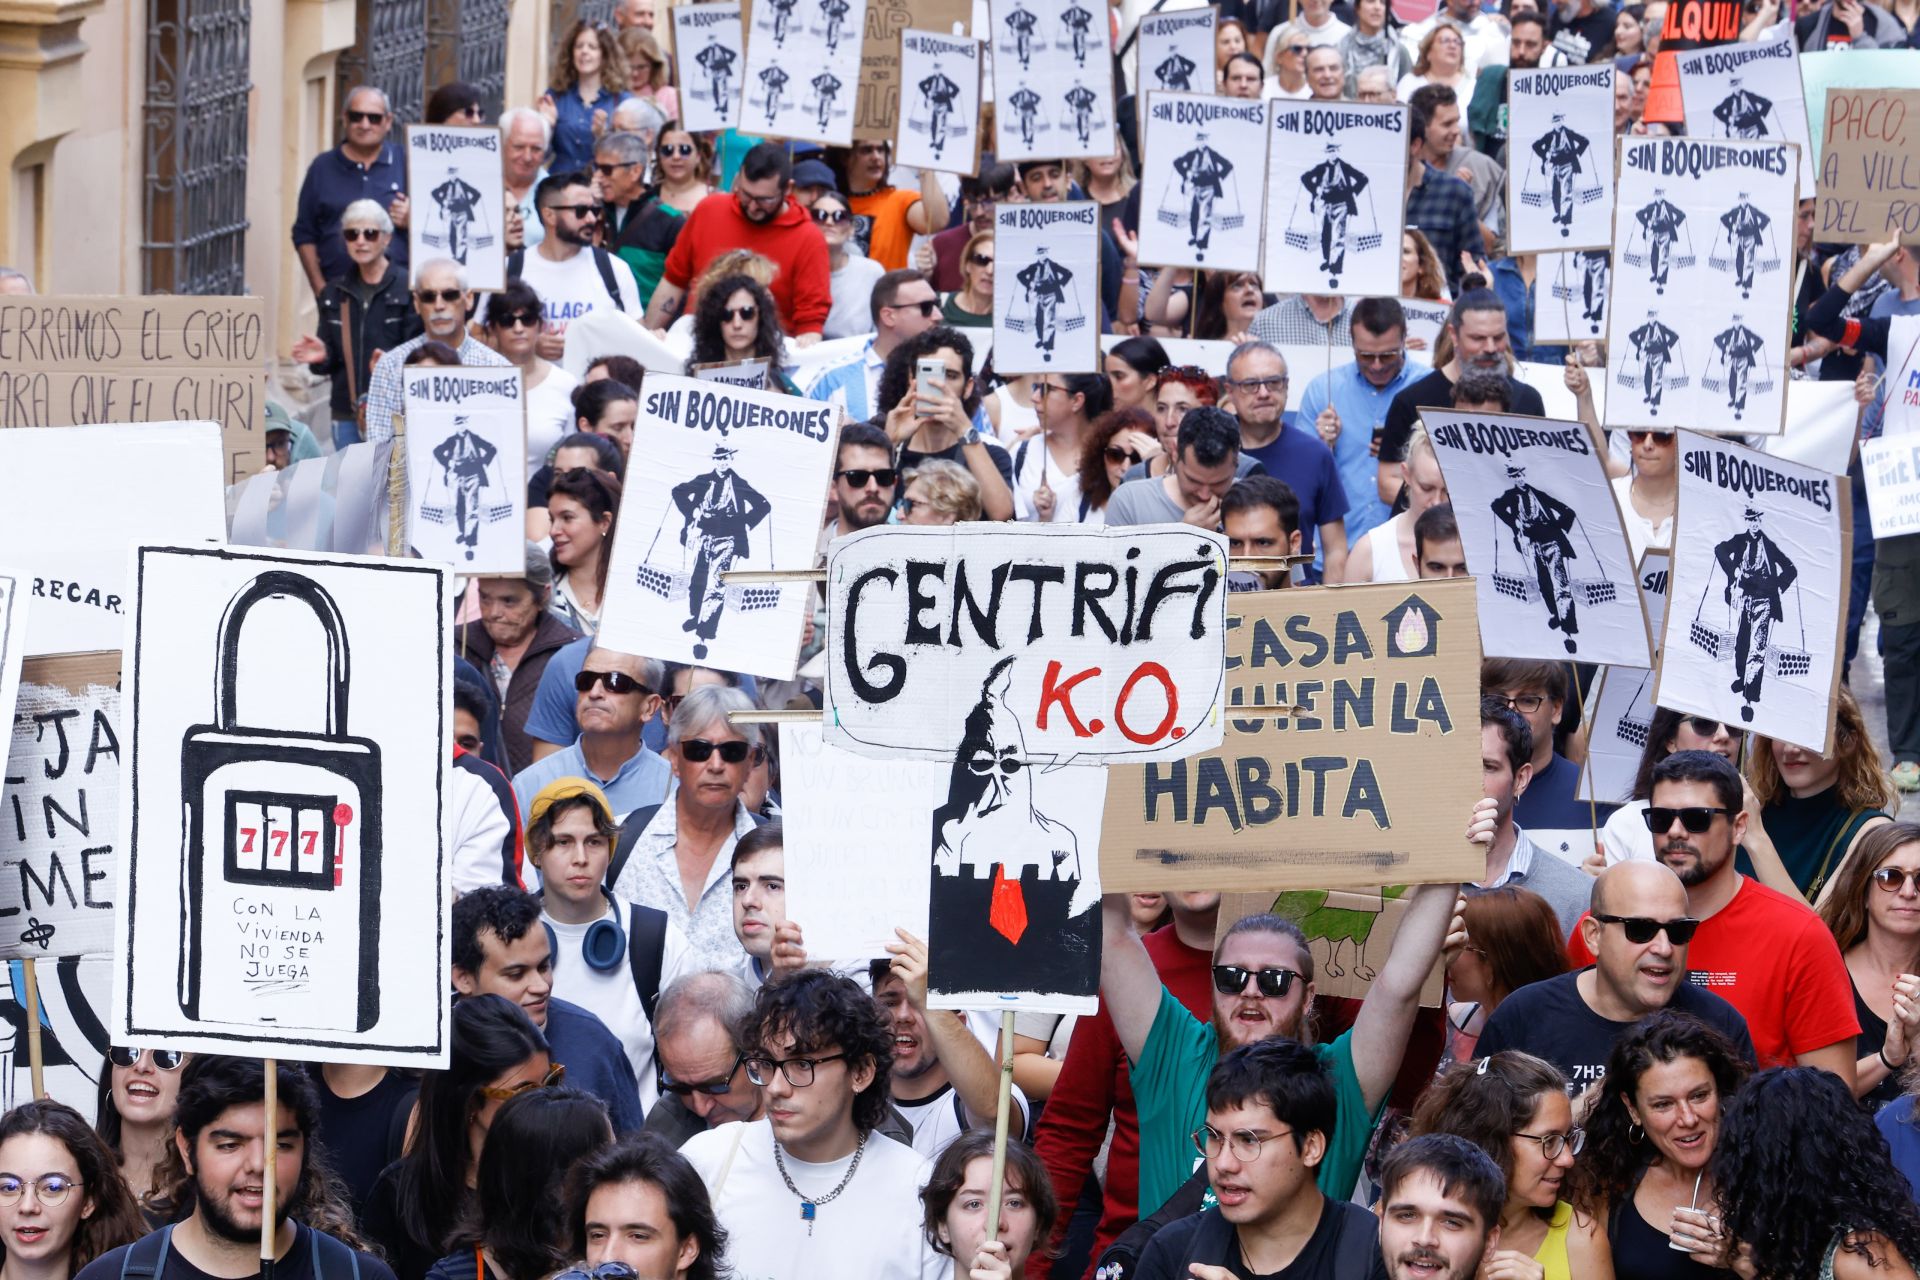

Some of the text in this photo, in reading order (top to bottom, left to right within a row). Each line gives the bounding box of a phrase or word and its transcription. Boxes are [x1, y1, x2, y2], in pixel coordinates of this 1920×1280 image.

[1683, 40, 1792, 76] SIN BOQUERONES
[1514, 68, 1611, 96] SIN BOQUERONES
[1153, 102, 1264, 126] SIN BOQUERONES
[1277, 110, 1402, 136] SIN BOQUERONES
[1829, 95, 1906, 146] PACO,
[412, 133, 497, 154] SIN BOQUERONES
[1627, 140, 1788, 179] SIN BOQUERONES
[1824, 152, 1839, 189] A
[999, 206, 1094, 229] SIN BOQUERONES
[1822, 199, 1866, 233] DEL
[142, 308, 173, 361] EL
[183, 309, 260, 361] GRIFO
[72, 374, 117, 425] QUE
[410, 376, 518, 404] SIN BOQUERONES
[646, 390, 831, 443] SIN BOQUERONES
[1434, 422, 1589, 458] SIN BOQUERONES
[1684, 451, 1832, 512] SIN BOQUERONES
[32, 577, 125, 614] RECAR
[1226, 675, 1456, 737] UIEN LA
[1143, 756, 1393, 835] HABITA
[295, 905, 322, 921] LA
[240, 943, 310, 960] NO SE
[246, 961, 309, 979] JUEGA
